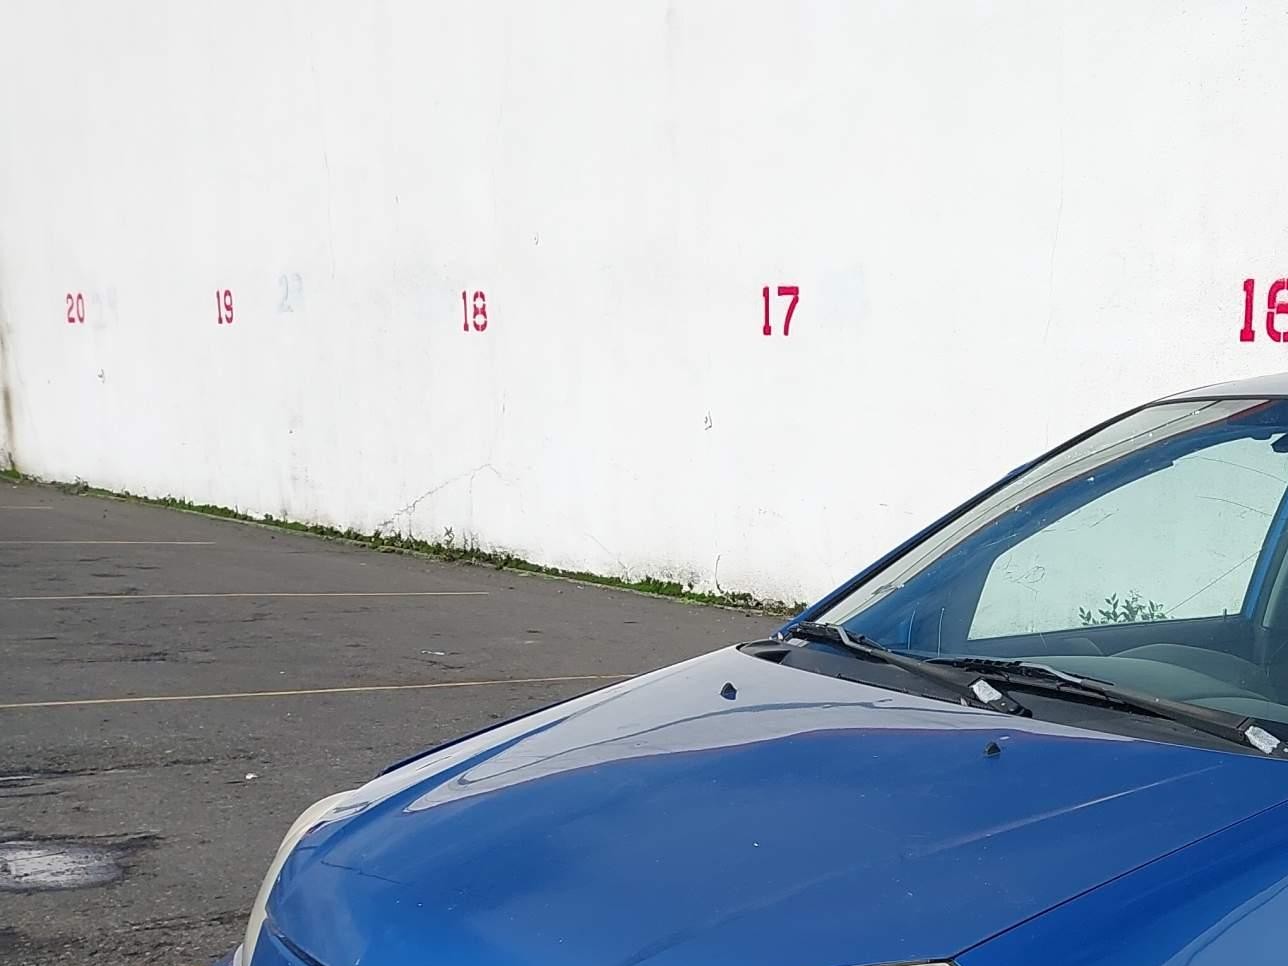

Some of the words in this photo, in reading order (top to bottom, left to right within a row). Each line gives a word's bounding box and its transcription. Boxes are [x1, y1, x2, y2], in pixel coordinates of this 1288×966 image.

[66, 293, 85, 324] 20
[216, 289, 234, 324] 19
[462, 291, 488, 333] 18
[761, 285, 800, 337] 17
